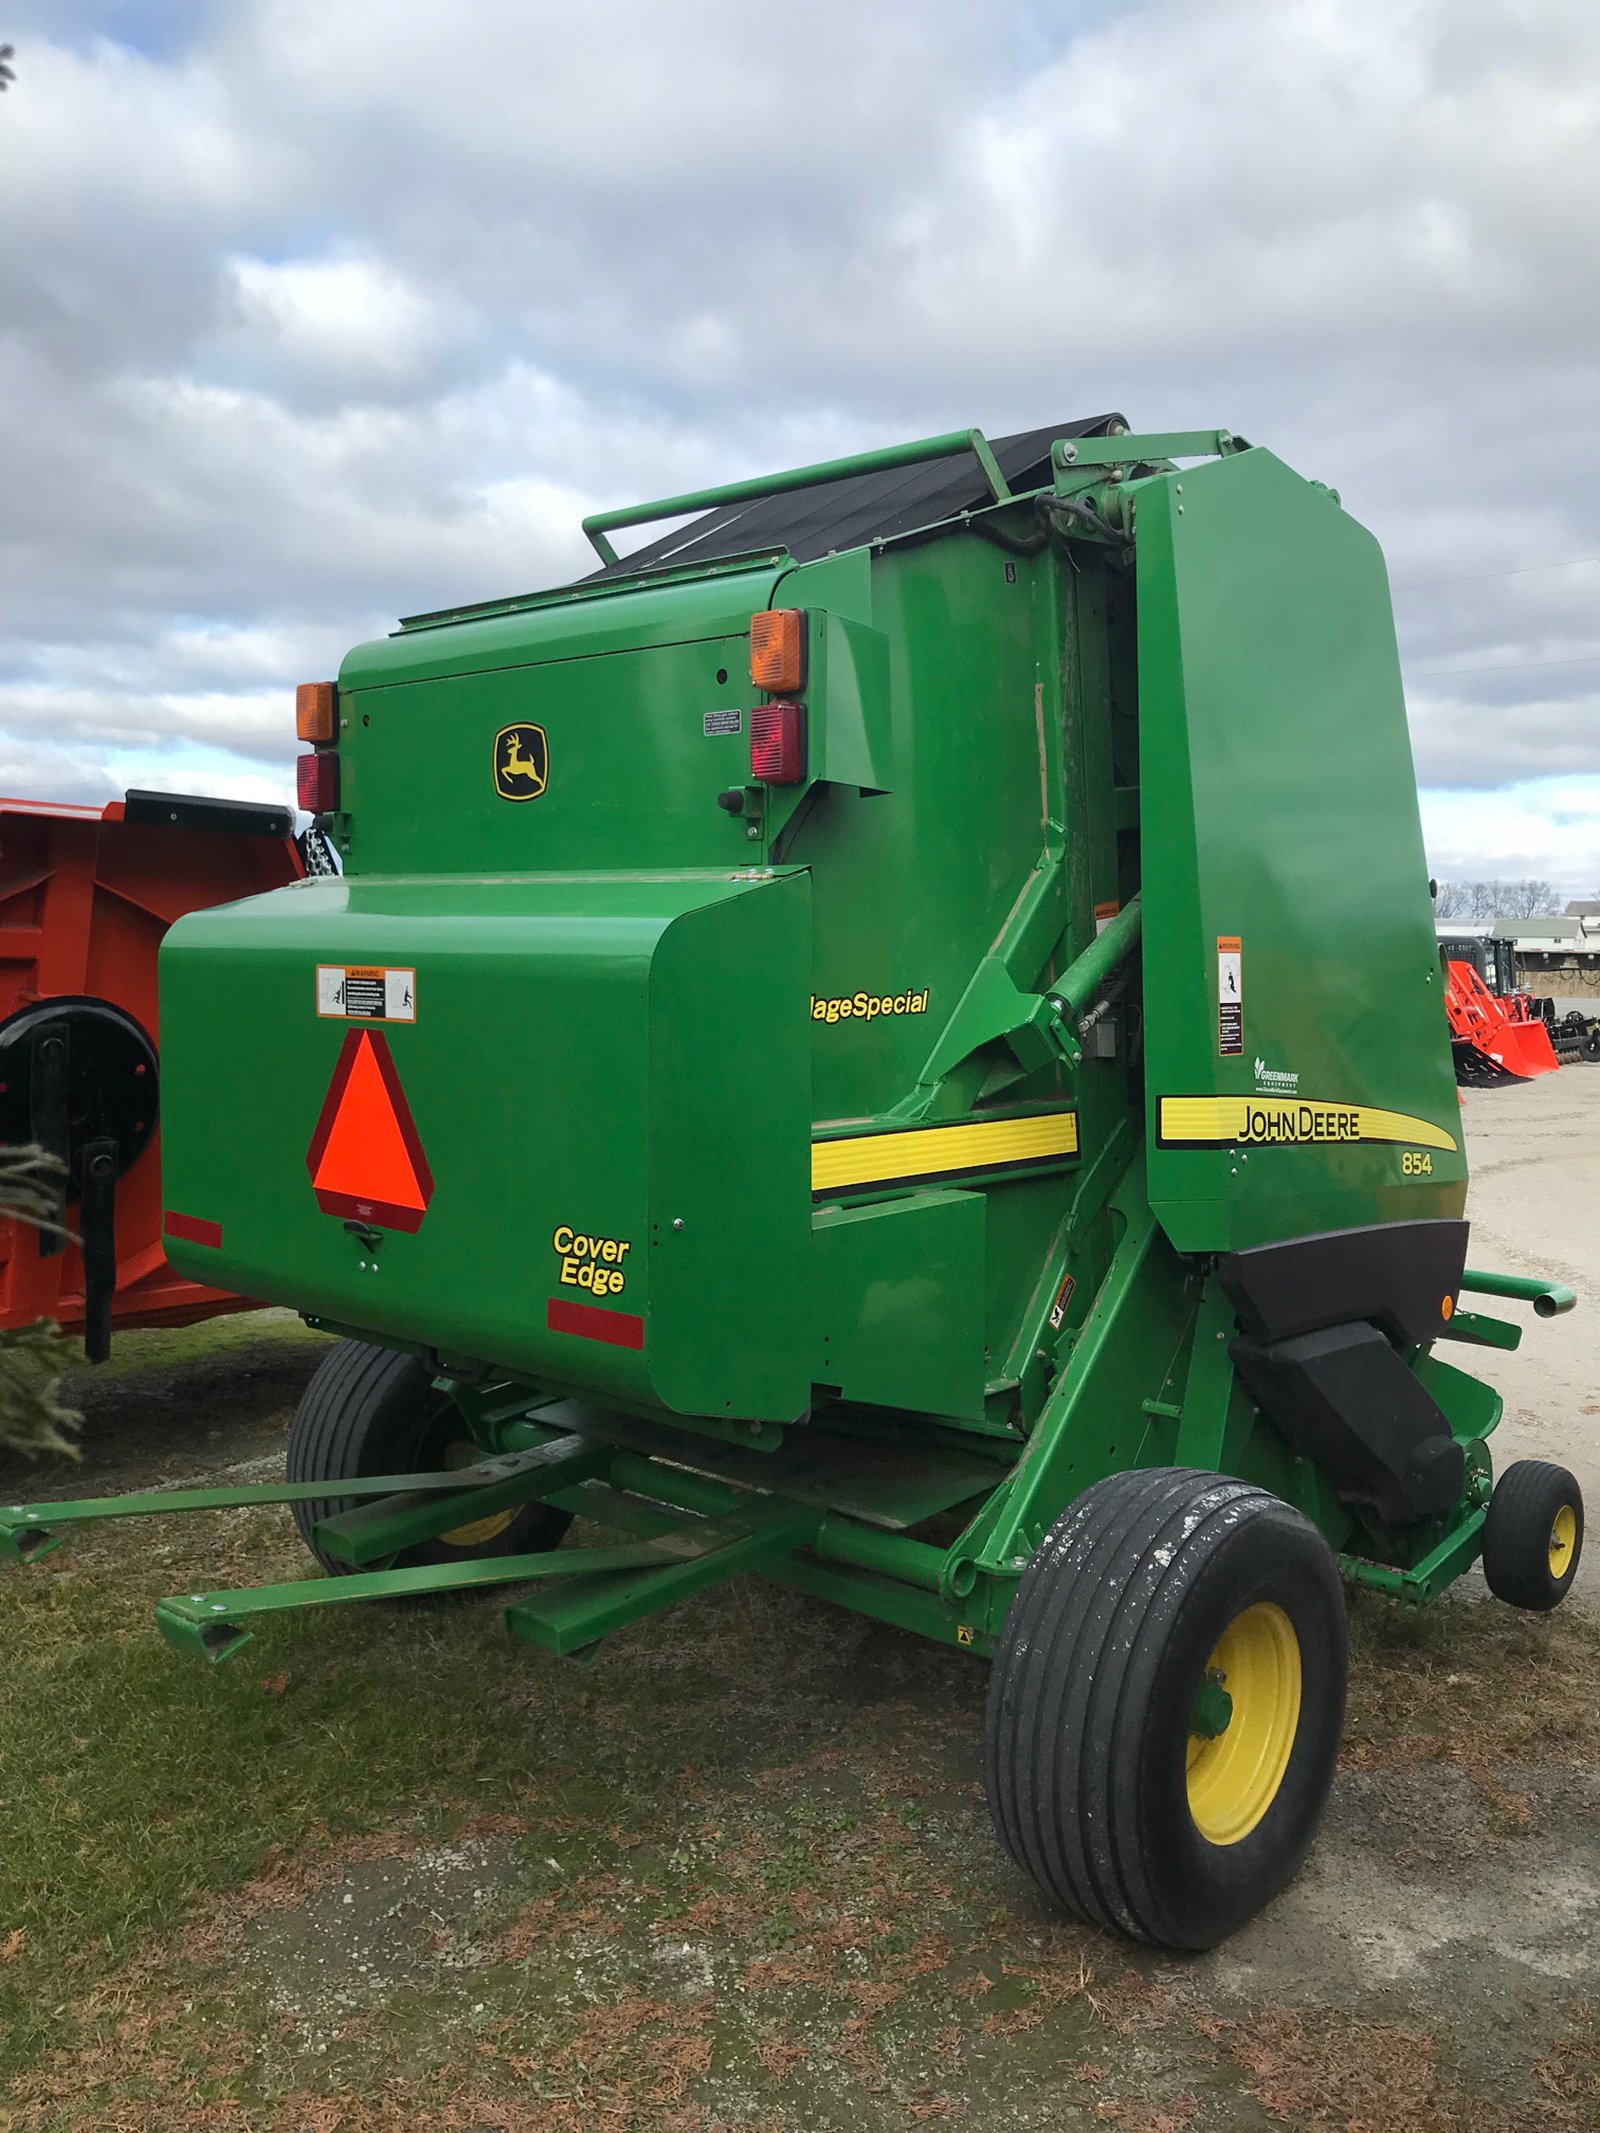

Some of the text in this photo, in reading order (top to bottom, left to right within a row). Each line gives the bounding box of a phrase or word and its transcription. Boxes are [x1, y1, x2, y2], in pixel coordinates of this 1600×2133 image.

[1260, 1070, 1299, 1083] GREENMARK
[1238, 1105, 1360, 1138] JOHN DEERE
[1401, 1151, 1433, 1176] 854
[553, 1226, 630, 1263] Cover
[560, 1256, 625, 1296] Edge
